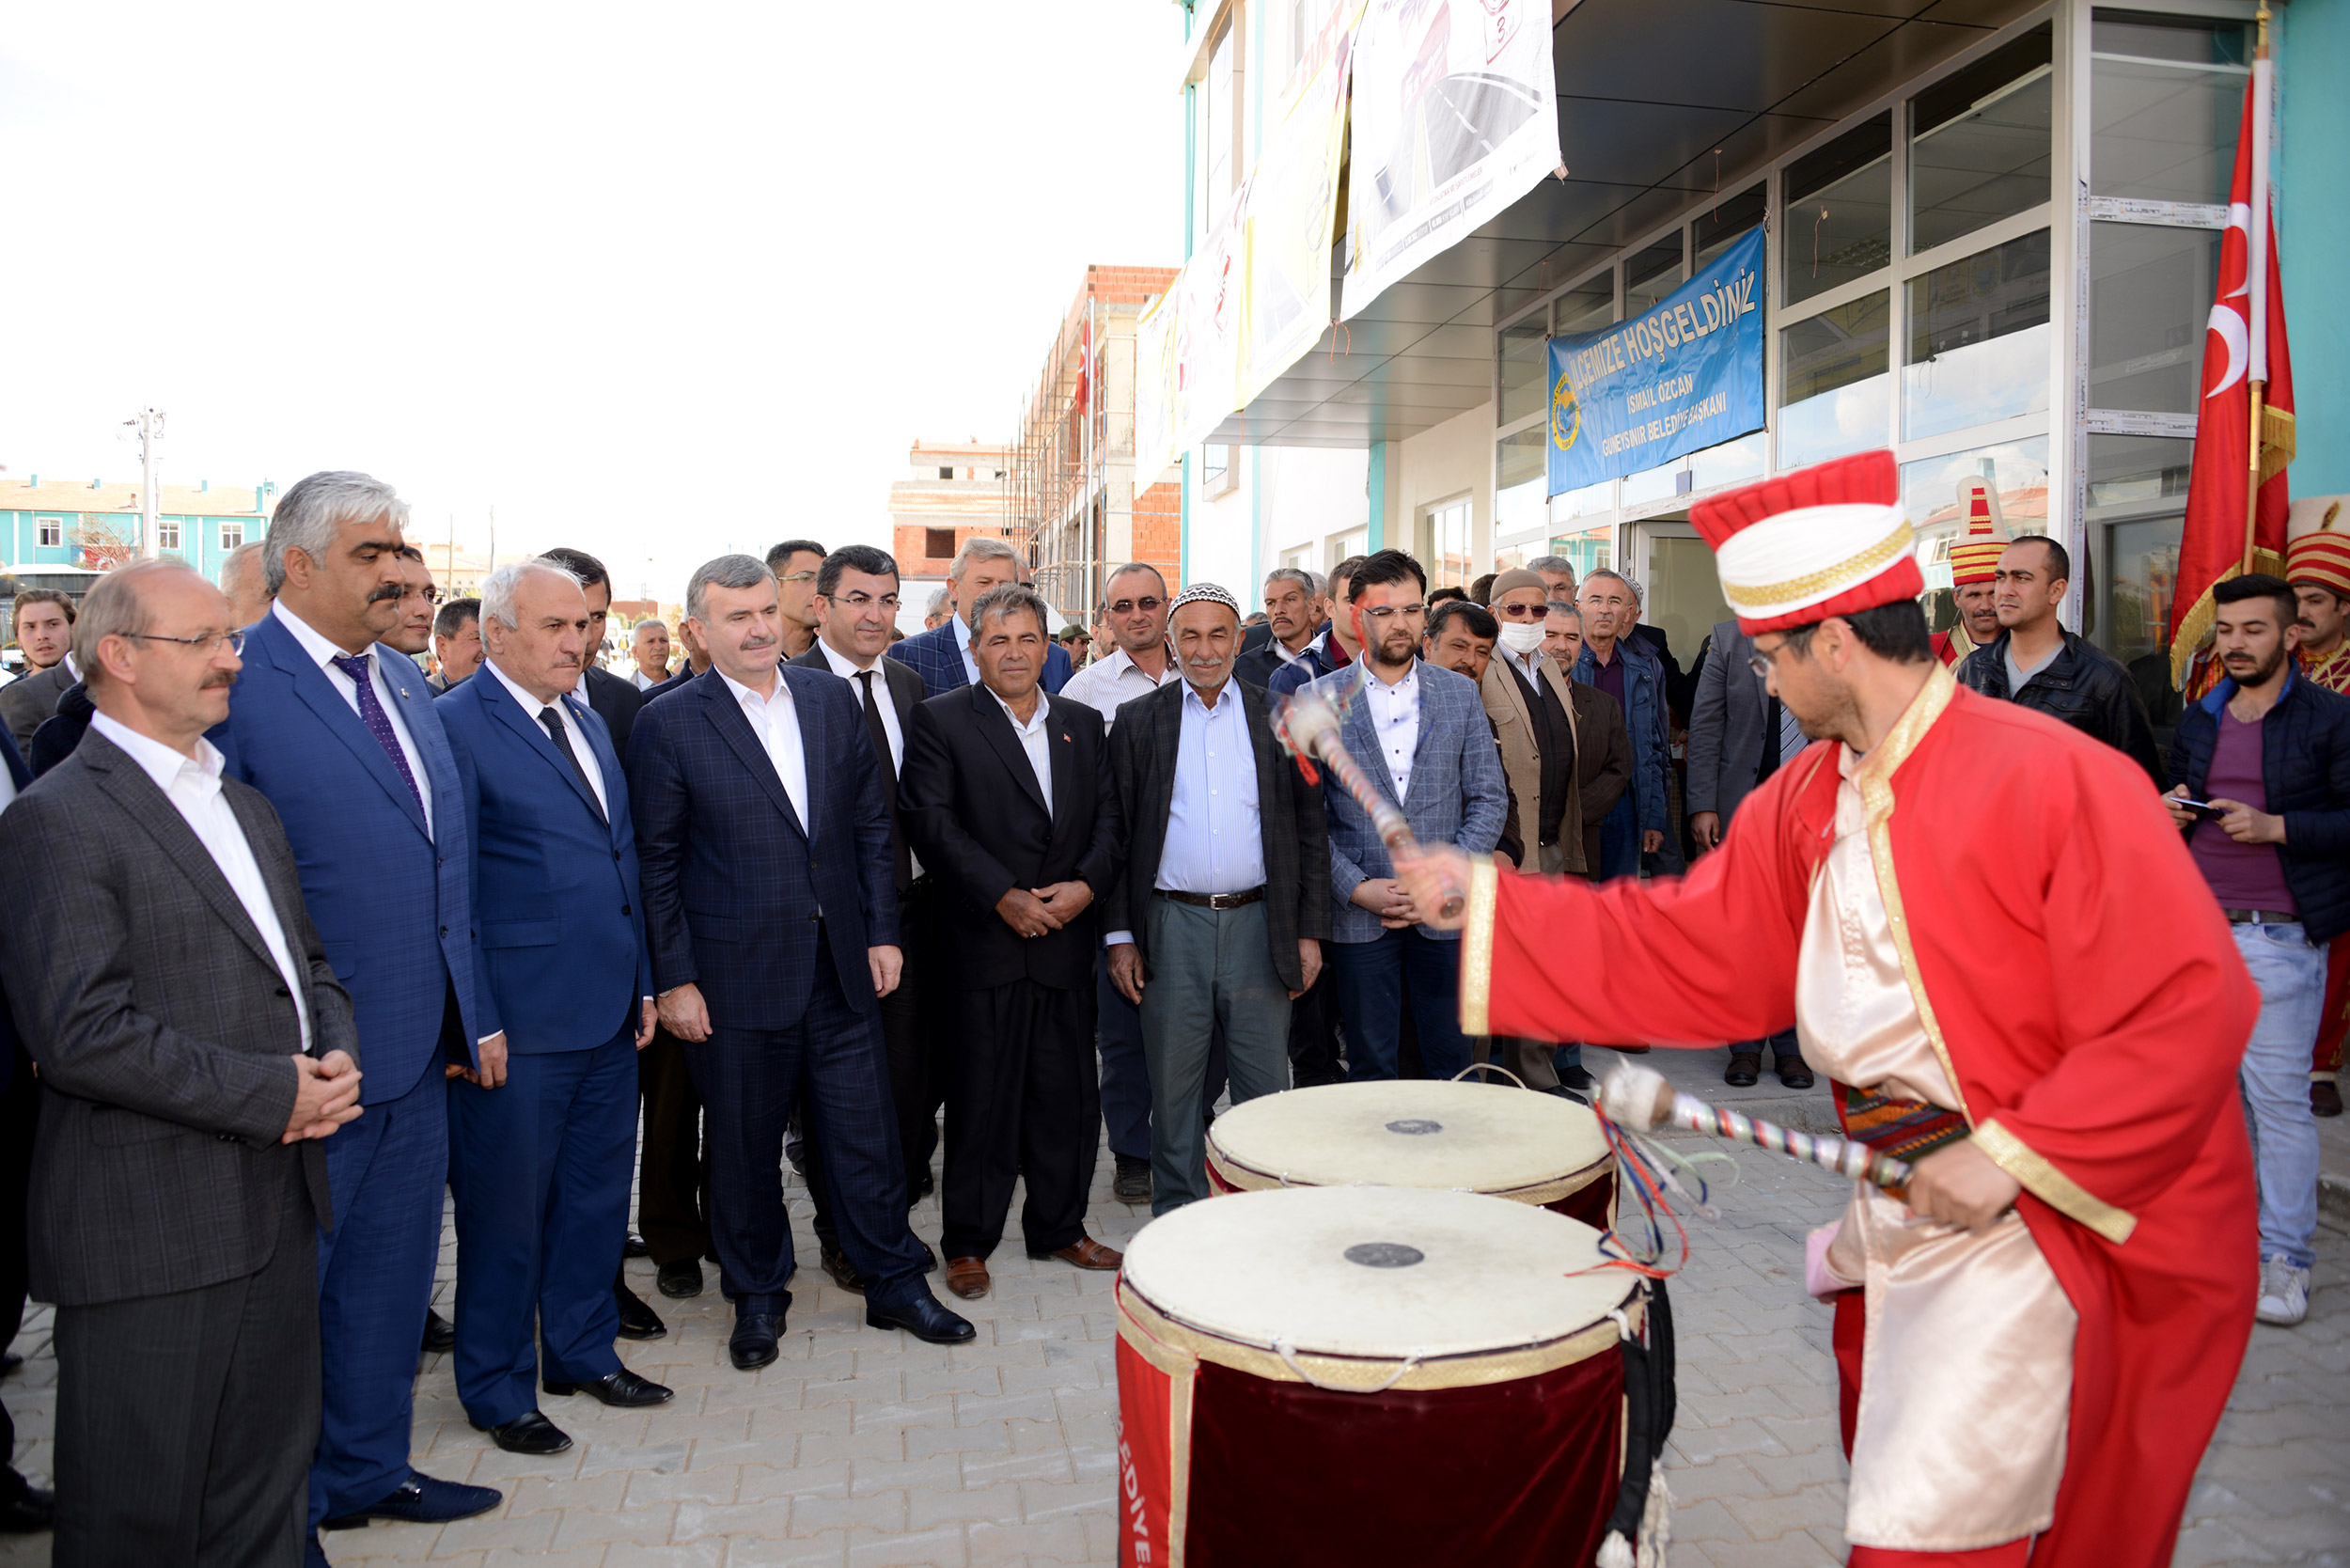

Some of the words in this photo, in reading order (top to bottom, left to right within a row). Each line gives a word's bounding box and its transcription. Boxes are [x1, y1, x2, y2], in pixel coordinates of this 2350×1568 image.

[1622, 267, 1755, 364] HOŞGELDİNİZ
[1602, 425, 1647, 457] GÜNEYSINIR
[1647, 408, 1689, 442] BELEDİYE
[1687, 391, 1727, 427] BAŞKANI
[1626, 384, 1657, 415] İSMAİL
[1658, 373, 1693, 403] ÖZCAN
